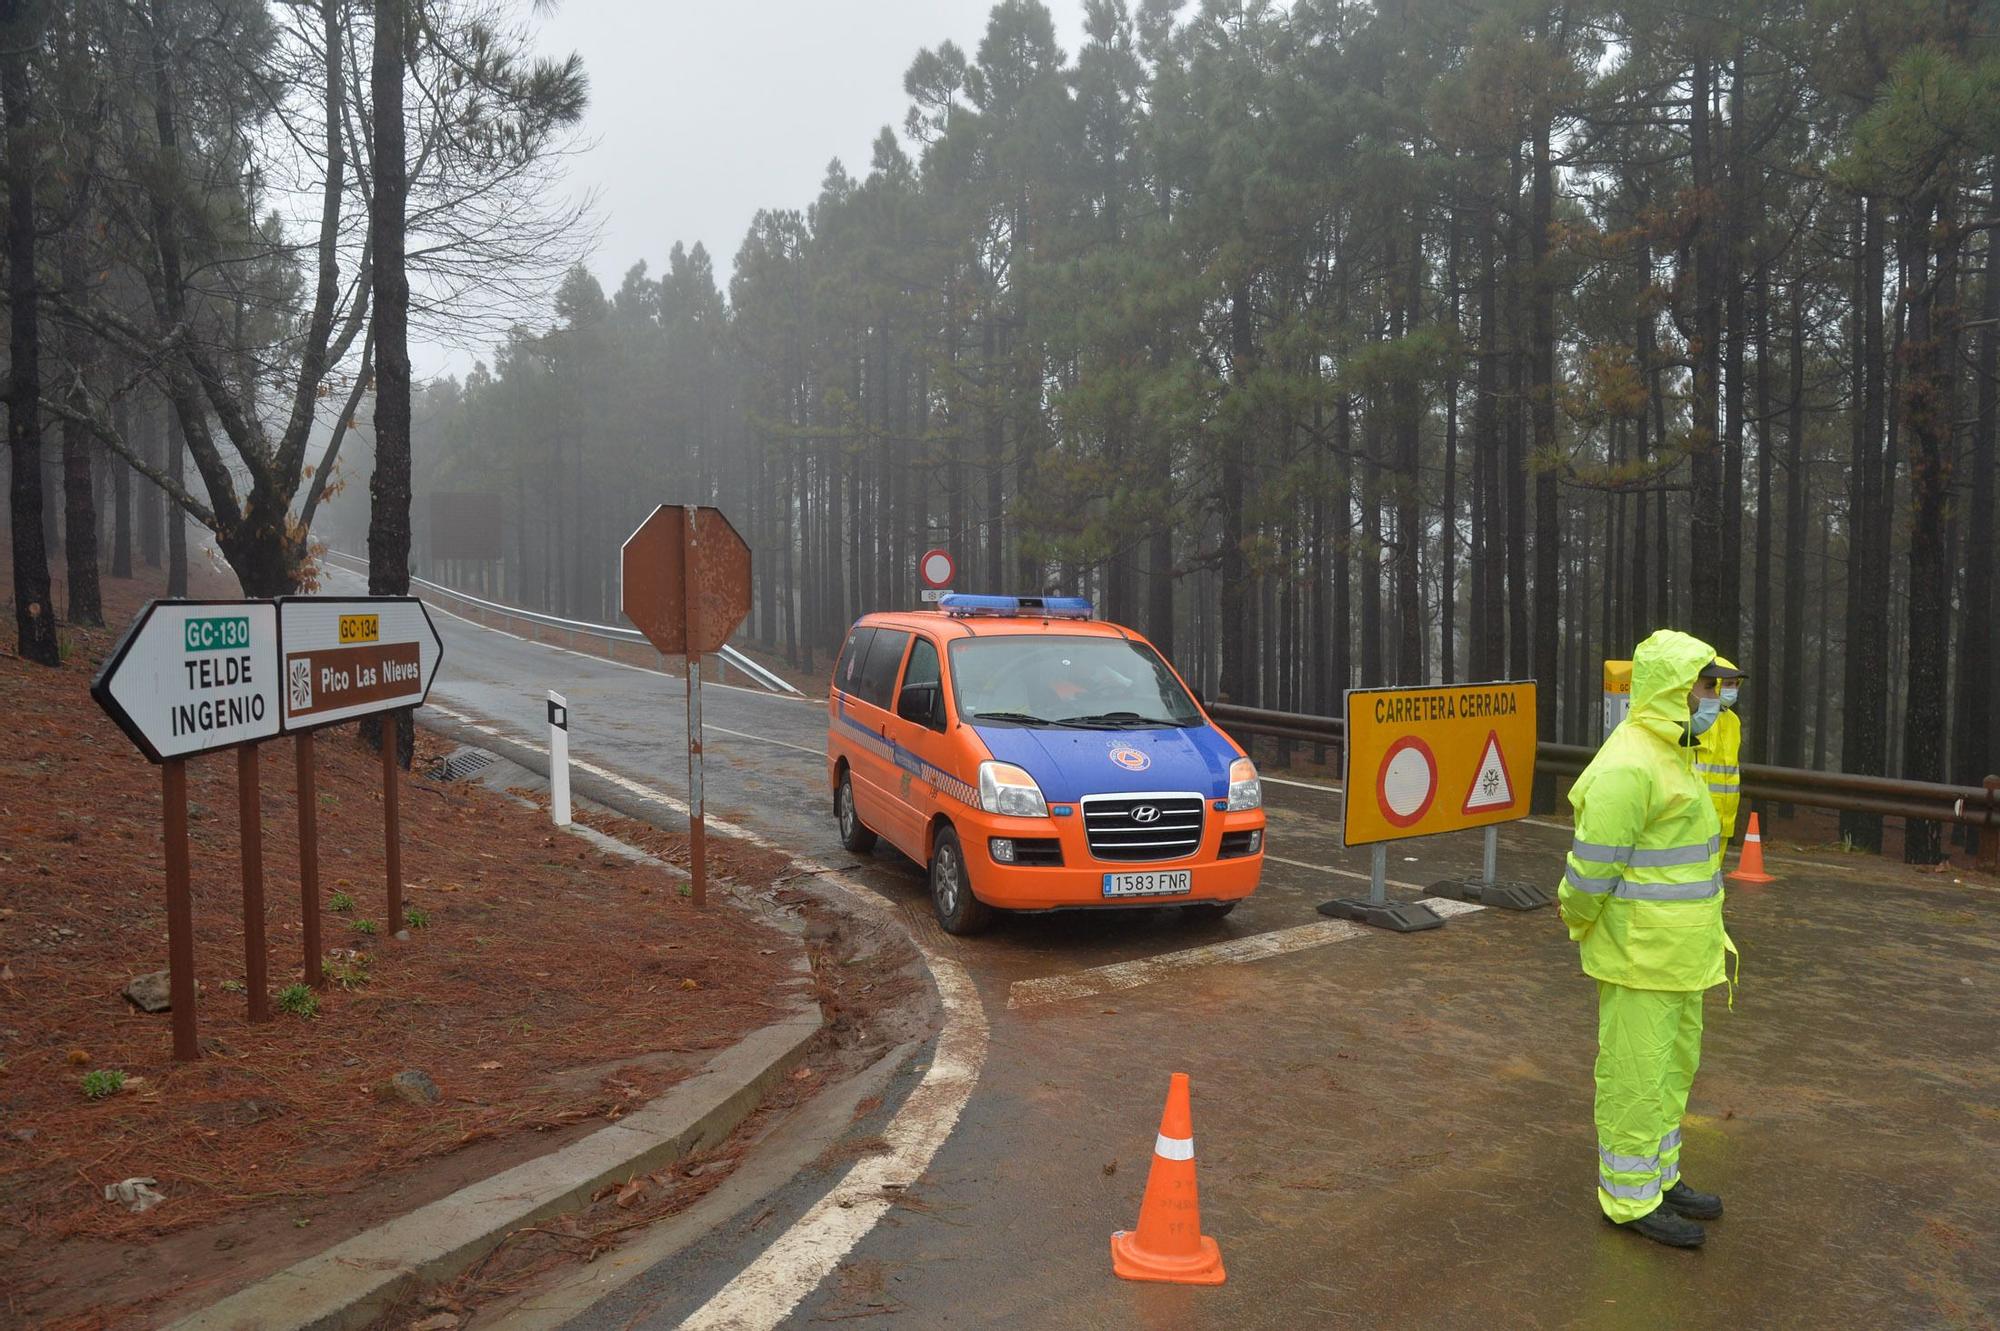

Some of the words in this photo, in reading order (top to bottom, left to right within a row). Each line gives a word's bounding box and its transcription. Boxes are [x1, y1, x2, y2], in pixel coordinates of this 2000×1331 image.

[187, 620, 248, 648] GC-130
[341, 619, 377, 638] GC-134
[184, 656, 252, 690] TELDE
[321, 666, 350, 693] Pico
[356, 663, 377, 688] Las
[382, 659, 419, 684] Nieves
[1619, 683, 1630, 692] GC
[171, 693, 265, 737] INGENIO
[1375, 696, 1456, 724] CARRETERA
[1459, 692, 1517, 718] CERRADA
[1116, 875, 1154, 892] 1583
[1159, 873, 1188, 889] FNR
